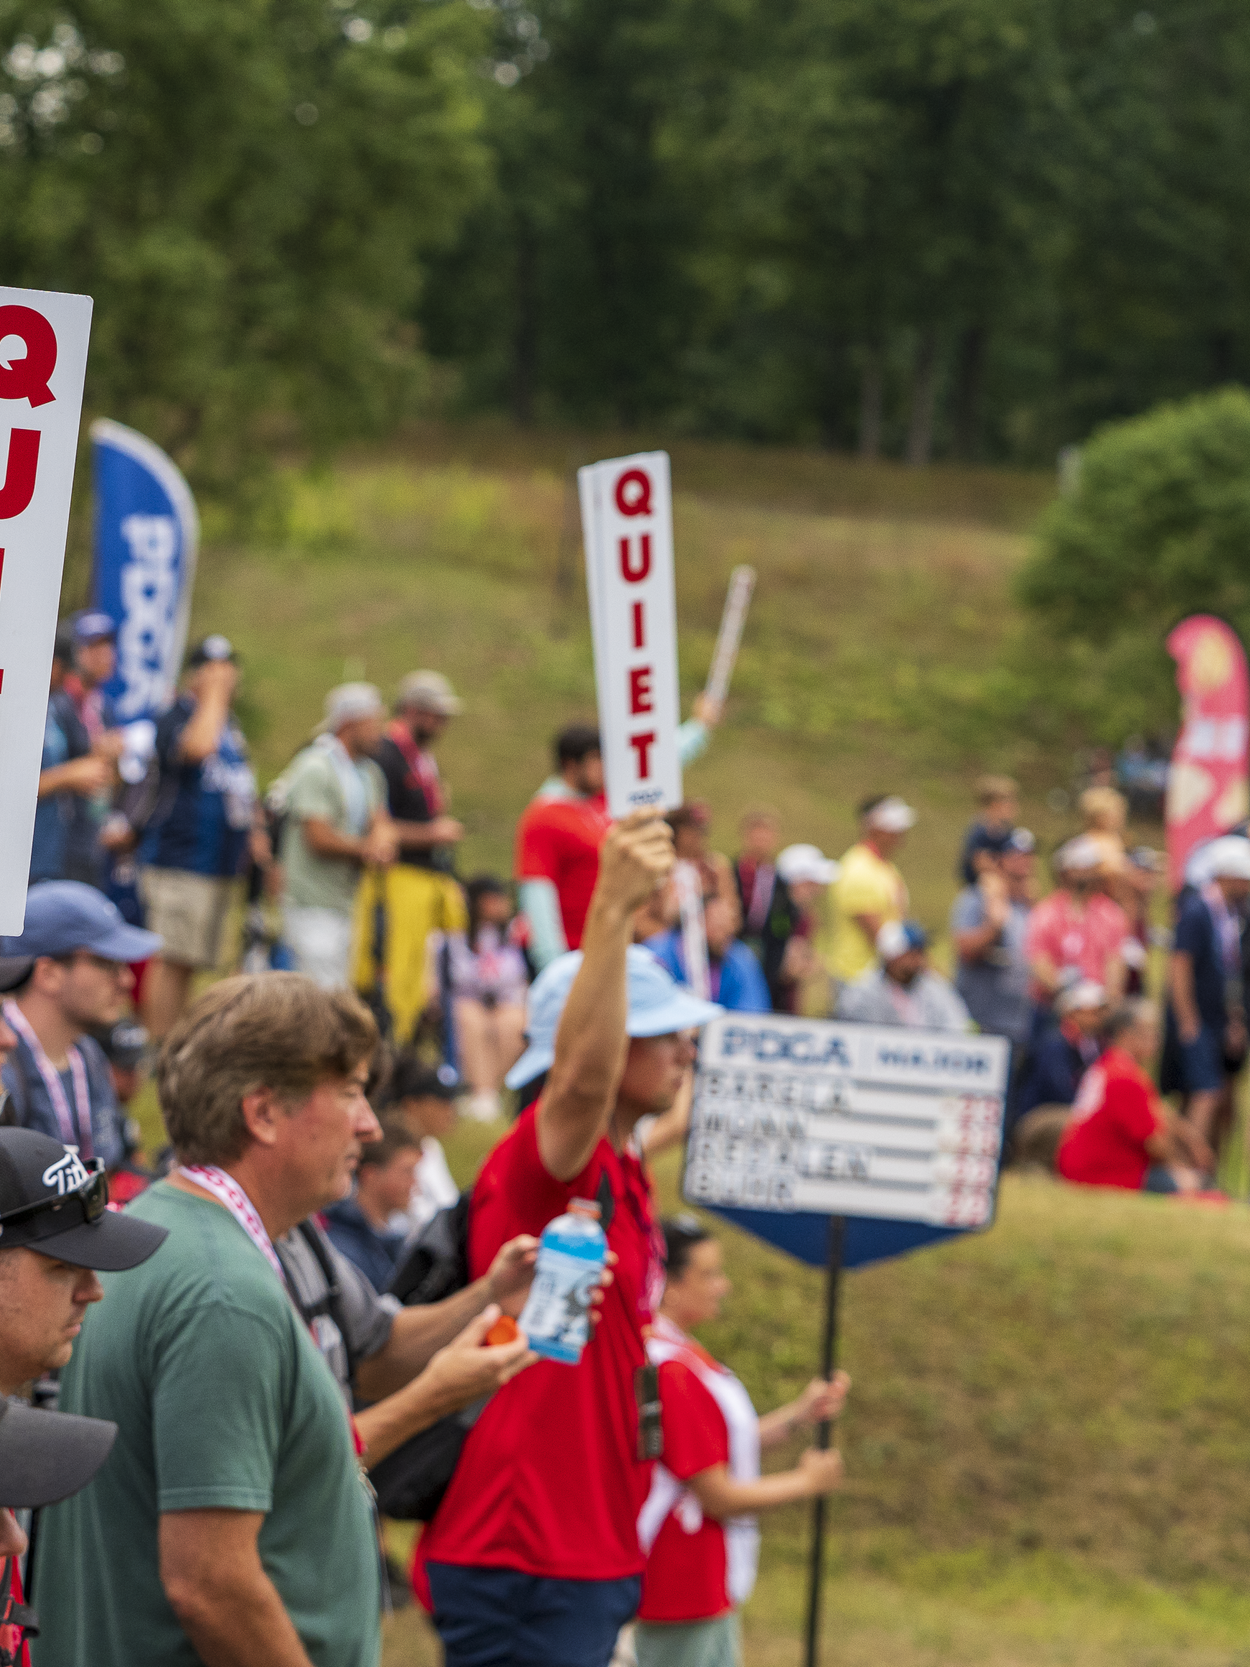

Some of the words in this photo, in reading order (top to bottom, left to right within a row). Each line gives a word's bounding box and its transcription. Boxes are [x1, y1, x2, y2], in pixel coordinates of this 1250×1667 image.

[615, 469, 656, 779] QUIET
[721, 1026, 852, 1067] PDGA
[878, 1046, 992, 1077] MAJOR
